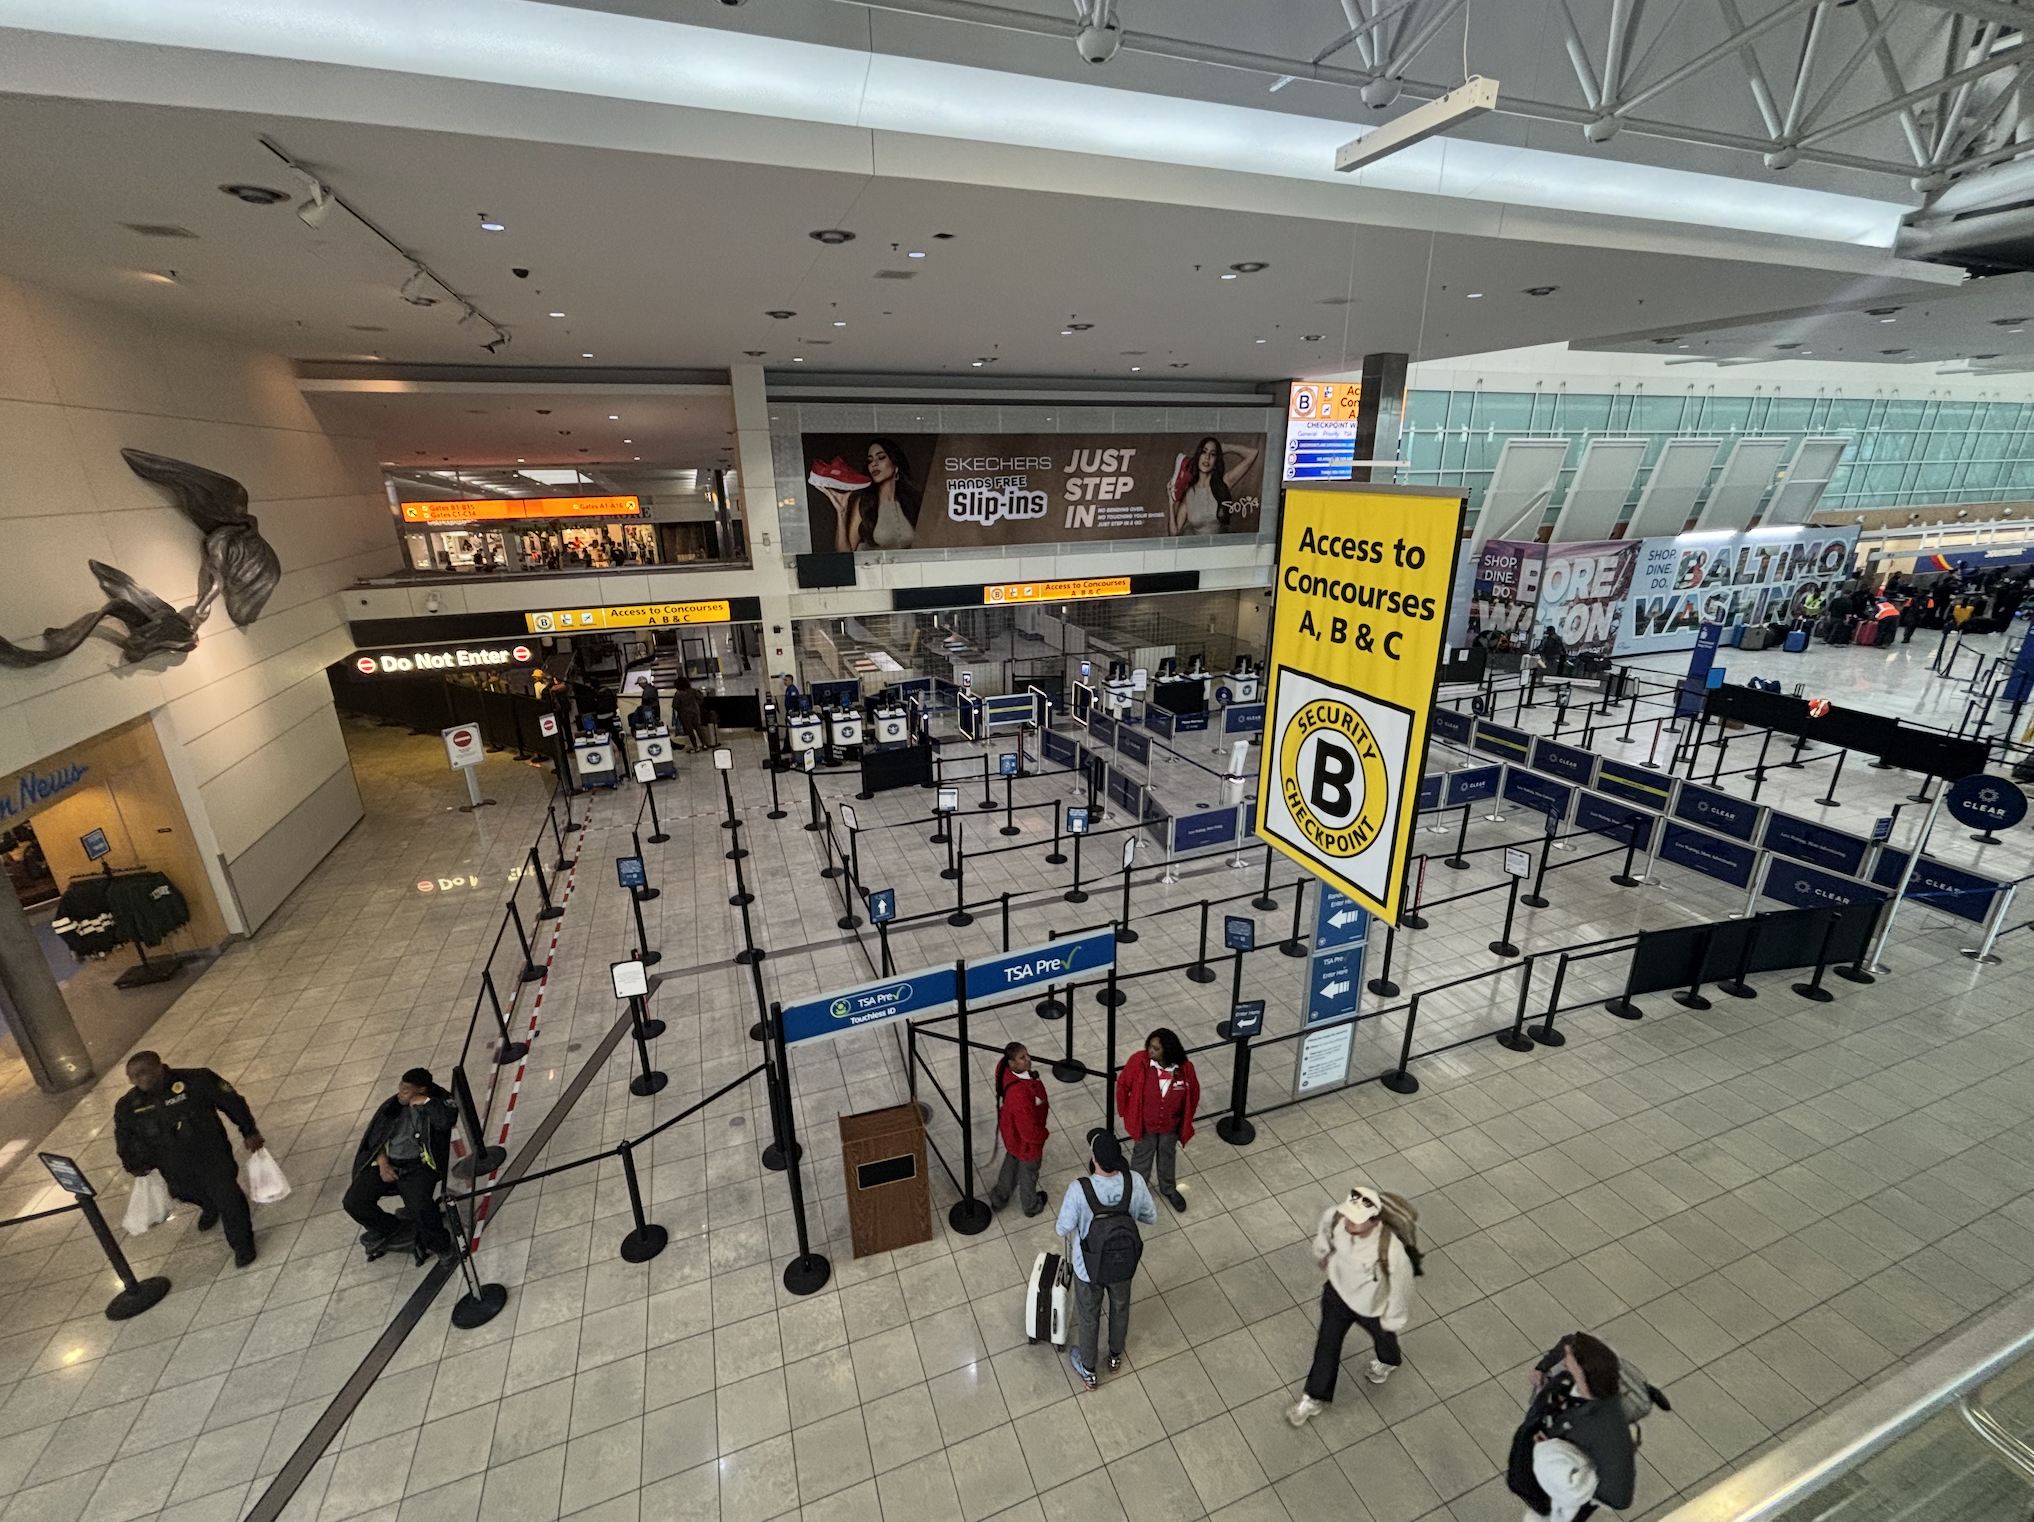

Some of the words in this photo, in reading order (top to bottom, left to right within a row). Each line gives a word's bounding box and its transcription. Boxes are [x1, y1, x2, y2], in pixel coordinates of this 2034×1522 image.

[1300, 395, 1310, 410] B
[945, 456, 1052, 472] SKECHERS
[1064, 448, 1136, 474] JUST
[947, 478, 992, 490] HANDS
[996, 476, 1027, 488] FREE
[1064, 476, 1135, 501] STEP
[953, 490, 1044, 521] Slip-ins
[1064, 505, 1096, 529] IN
[1298, 526, 1383, 564] Access
[1394, 538, 1426, 570] to
[1648, 549, 1676, 560] SHOP.
[1484, 554, 1518, 569] SHOP.
[1646, 564, 1673, 575] DINE.
[1672, 537, 1851, 591] BALTIMO
[1083, 580, 1126, 588] Concourses
[1484, 570, 1515, 584] DINE.
[1650, 578, 1668, 588] DO.
[1284, 566, 1436, 621] Concourses
[1492, 586, 1512, 598] DO.
[611, 606, 646, 617] Access
[651, 606, 661, 615] to
[664, 603, 724, 614] Concourses
[540, 618, 548, 627] B
[1298, 610, 1322, 642] A,
[1330, 616, 1348, 644] B
[1355, 622, 1374, 654] &
[1384, 631, 1403, 660] C
[380, 655, 413, 673] Do
[414, 651, 456, 670] Not
[456, 649, 510, 667] Enter
[1297, 704, 1377, 761] SECURITY
[1559, 758, 1578, 768] CLEAR
[1310, 737, 1356, 819] B
[1470, 781, 1486, 789] CLEAR
[18, 764, 90, 810] News
[1284, 776, 1376, 854] CHECKPOINT
[1710, 807, 1736, 820] CLEAR
[1963, 800, 2006, 816] CLEAR
[1925, 878, 1962, 894] CLEAR
[1814, 888, 1850, 905] CLEAR
[1004, 964, 1033, 983] TSA
[1036, 957, 1061, 974] Pre
[1323, 972, 1336, 980] Enter
[1336, 969, 1348, 977] Here
[858, 996, 876, 1008] TSA
[876, 993, 893, 1004] Pre
[850, 1010, 886, 1025] Touchless
[887, 1007, 896, 1017] ID
[164, 1093, 187, 1106] POLICE
